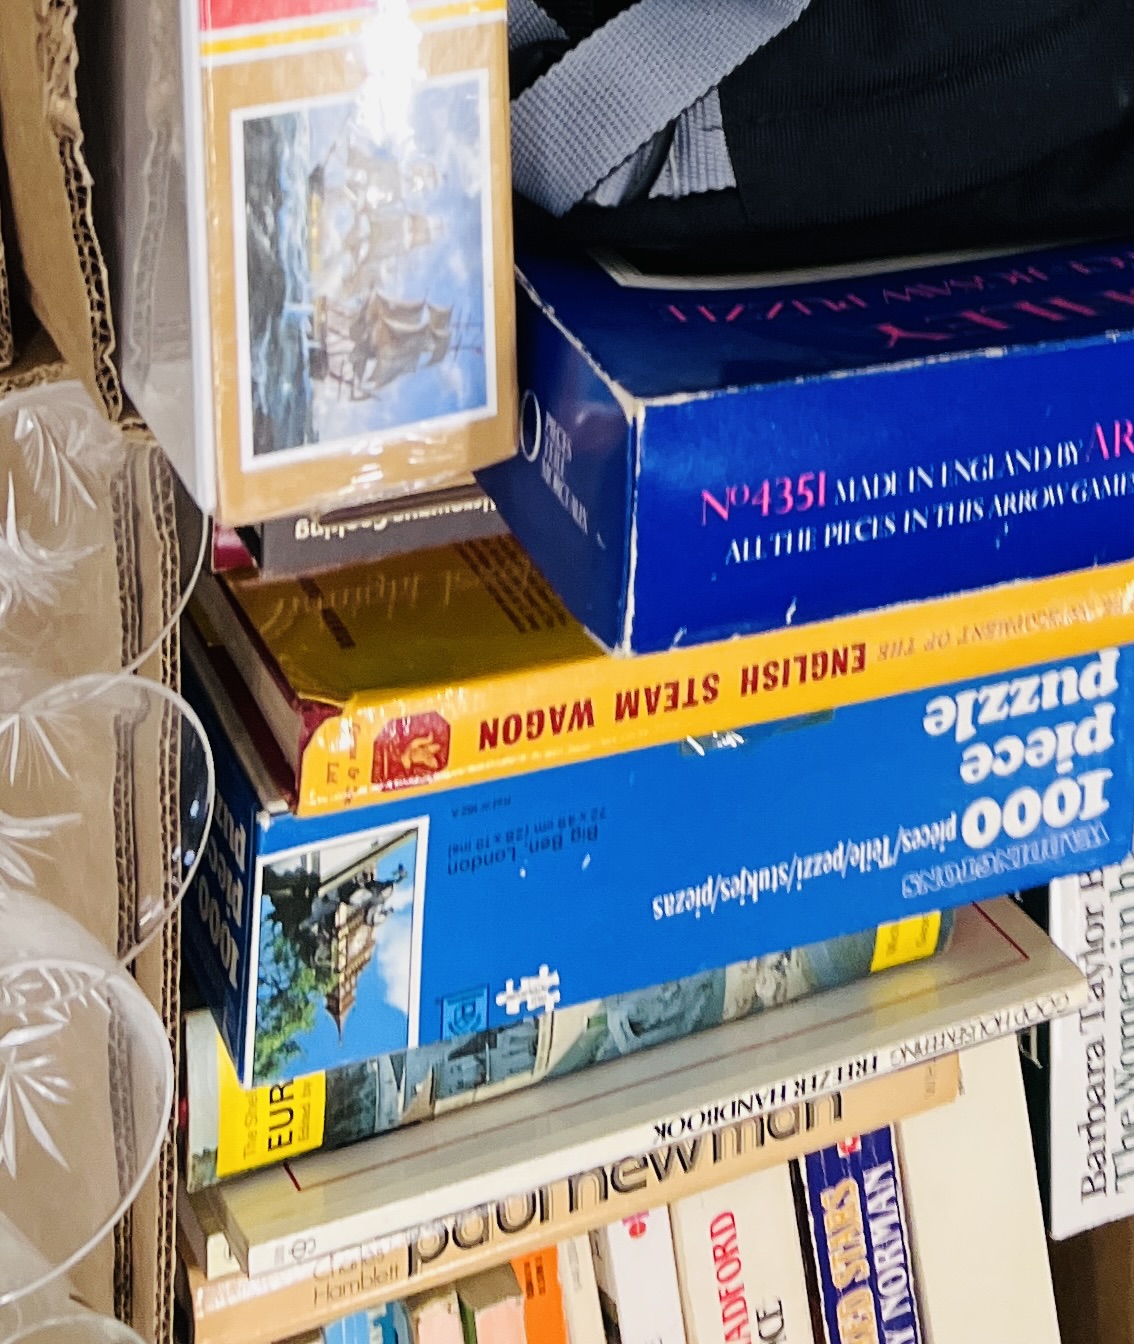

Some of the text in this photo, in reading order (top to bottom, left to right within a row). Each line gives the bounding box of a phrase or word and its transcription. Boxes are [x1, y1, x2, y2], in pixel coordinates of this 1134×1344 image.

[833, 471, 897, 506] MADE
[908, 465, 935, 494] IN
[939, 443, 1053, 489] ENGLAND
[1056, 438, 1084, 468] BY
[725, 529, 764, 566] ALL
[767, 522, 818, 558] THE
[824, 515, 896, 546] PIECES
[901, 508, 929, 535] IN
[929, 497, 986, 529] THIS
[993, 482, 1068, 521] ARROW
[615, 672, 720, 724] STEAM
[740, 641, 867, 697] ENGLISH
[923, 647, 1121, 744] puzzle
[479, 697, 597, 752] WAGON
[958, 702, 1117, 786] piece
[568, 825, 599, 849] Big
[961, 768, 1114, 851] 1000
[447, 848, 518, 876] London
[1008, 991, 1071, 1022] GOOD
[1075, 904, 1115, 1035] Taylor
[268, 1078, 294, 1149] EUR
[653, 1079, 790, 1146] HANDBOOK
[793, 1051, 881, 1099] FREEZER
[567, 1086, 844, 1214] newman
[1076, 1033, 1107, 1205] Barbara
[830, 1177, 874, 1281] STARS
[862, 1165, 911, 1300] NORMAN
[710, 1211, 751, 1344] ADFORD
